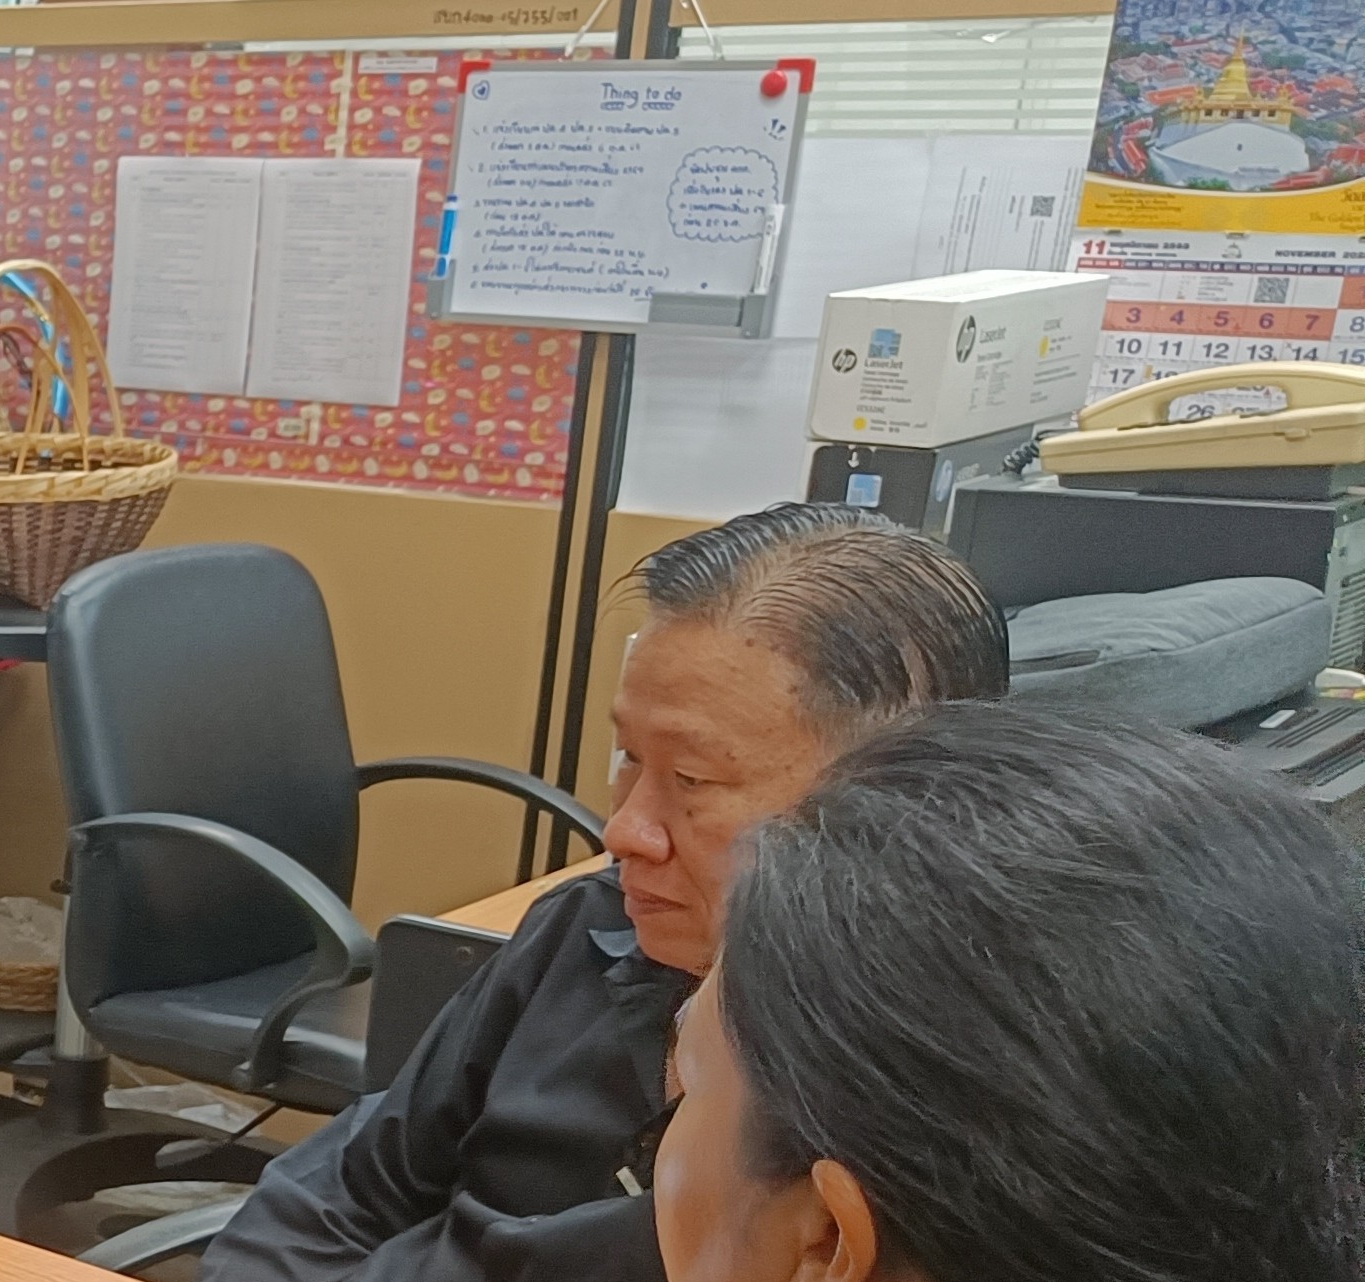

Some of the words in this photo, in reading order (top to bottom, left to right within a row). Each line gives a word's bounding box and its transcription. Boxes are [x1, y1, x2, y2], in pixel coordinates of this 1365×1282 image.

[601, 83, 639, 108] Thing
[646, 86, 660, 100] to
[665, 85, 683, 101] do
[1082, 239, 1107, 255] 11
[1275, 249, 1336, 259] NOVEMBER
[1342, 251, 1365, 259] 202
[1126, 307, 1141, 324] 3
[1170, 310, 1184, 325] 4
[1214, 312, 1229, 327] 5
[1259, 313, 1274, 329] 6
[1305, 314, 1320, 331] 7
[1350, 316, 1365, 332] 8
[1116, 339, 1142, 355] 10
[1159, 340, 1183, 356] 11
[1203, 343, 1229, 359] 12
[1247, 345, 1273, 361] 13
[1292, 346, 1318, 361] 14
[1339, 348, 1365, 364] 15
[864, 359, 903, 370] LaserJet
[1109, 369, 1135, 384] 17
[1187, 404, 1215, 418] 26
